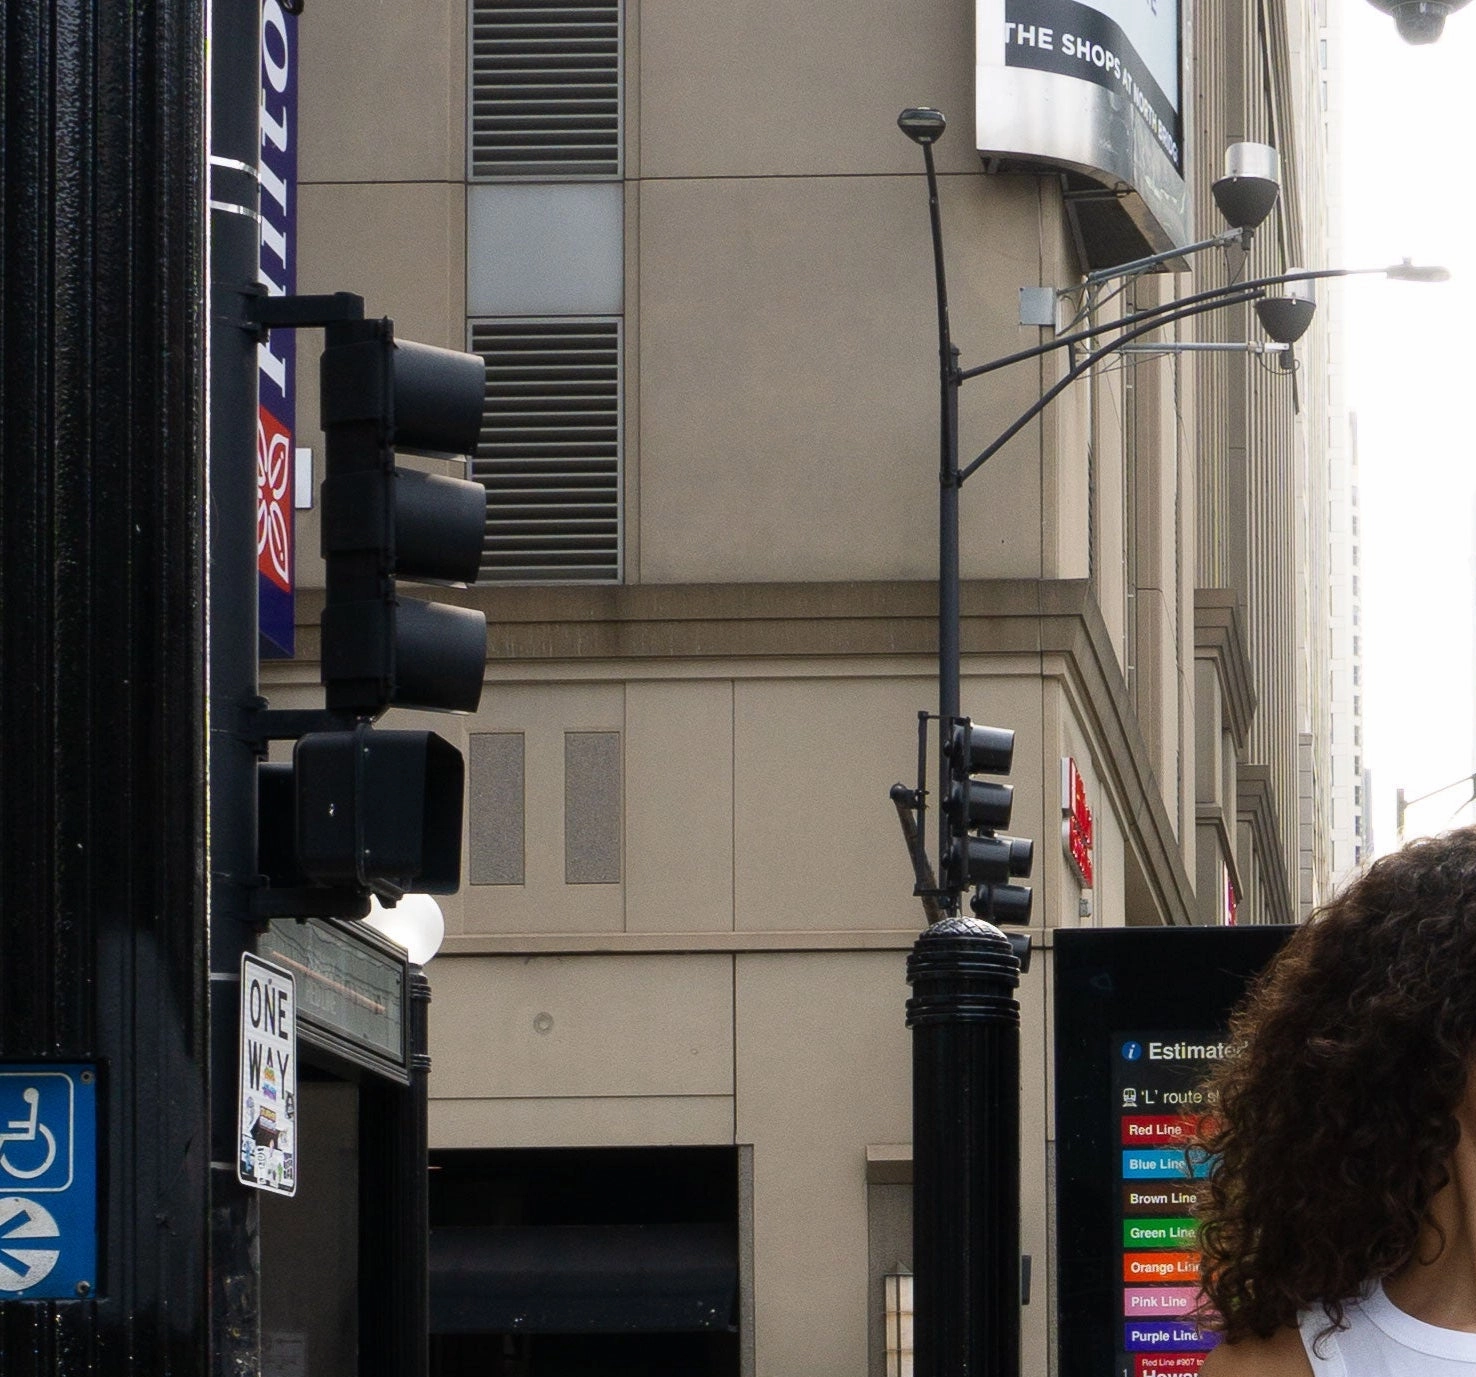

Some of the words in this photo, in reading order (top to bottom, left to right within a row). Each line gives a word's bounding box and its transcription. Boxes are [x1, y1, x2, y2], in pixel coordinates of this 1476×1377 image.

[1005, 22, 1054, 50] THE
[1061, 33, 1122, 80] SHOPS
[1122, 67, 1133, 95] AT
[1133, 82, 1158, 134] NORTH
[1158, 118, 1179, 164] BRIDG
[250, 978, 289, 1041] ONE
[1163, 1089, 1203, 1105] route
[1129, 1123, 1153, 1136] Red
[1156, 1123, 1182, 1136] Line
[1129, 1159, 1157, 1170] Blue
[1160, 1158, 1187, 1170] Line
[1130, 1193, 1168, 1204] Brown
[1171, 1192, 1197, 1204] Line
[1130, 1227, 1166, 1239] Green
[1169, 1227, 1196, 1239] Line
[1130, 1261, 1174, 1275] Orange
[1131, 1296, 1158, 1307] Pink
[1161, 1295, 1187, 1307] Line
[1131, 1330, 1170, 1344] Purple
[1173, 1330, 1199, 1341] Line
[1142, 1358, 1158, 1367] Red
[1159, 1358, 1175, 1367] Line
